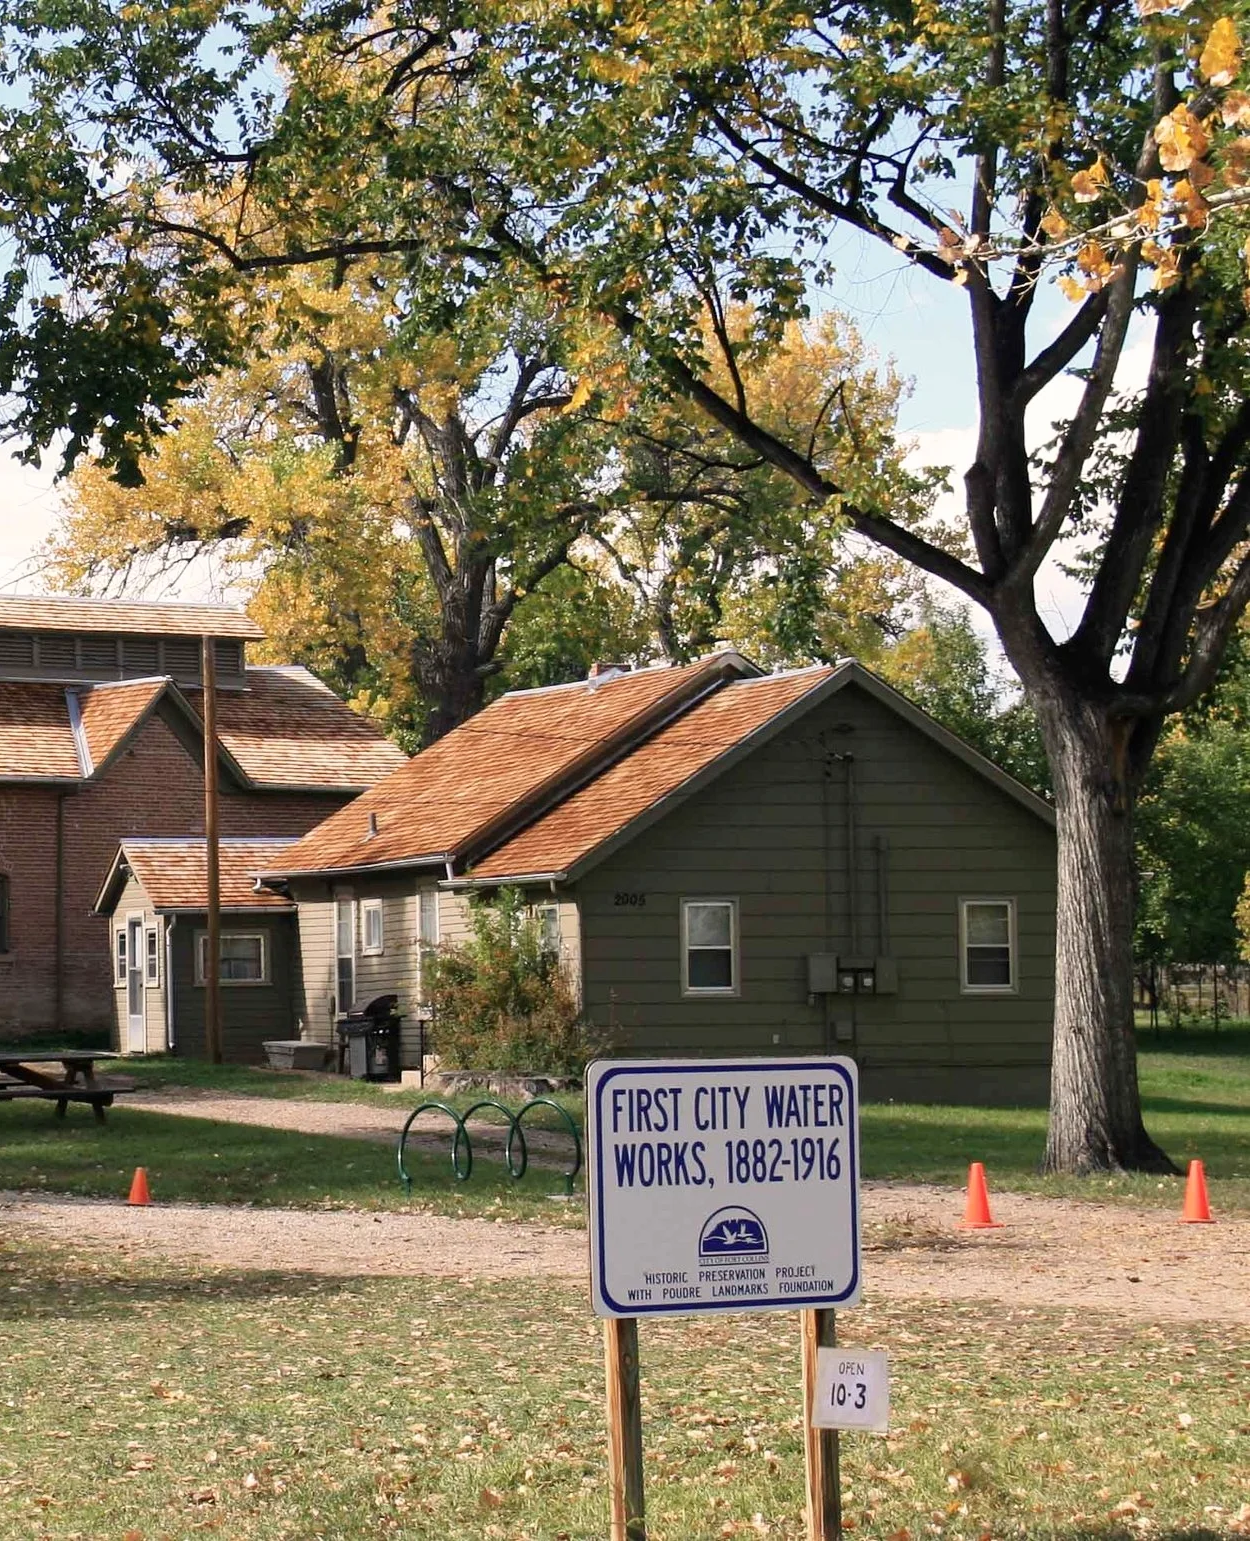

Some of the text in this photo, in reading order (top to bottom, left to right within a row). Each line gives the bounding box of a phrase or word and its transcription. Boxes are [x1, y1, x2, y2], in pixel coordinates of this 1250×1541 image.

[612, 1084, 845, 1133] FIRST CITY WATER
[614, 1137, 842, 1189] WORKS, 1882-1916
[645, 1266, 816, 1285] HISTORIC PRESERVATION PROJECT
[628, 1280, 834, 1301] WITH POUDRE LANDMARKS FOUNDATION
[838, 1362, 865, 1376] OPEN
